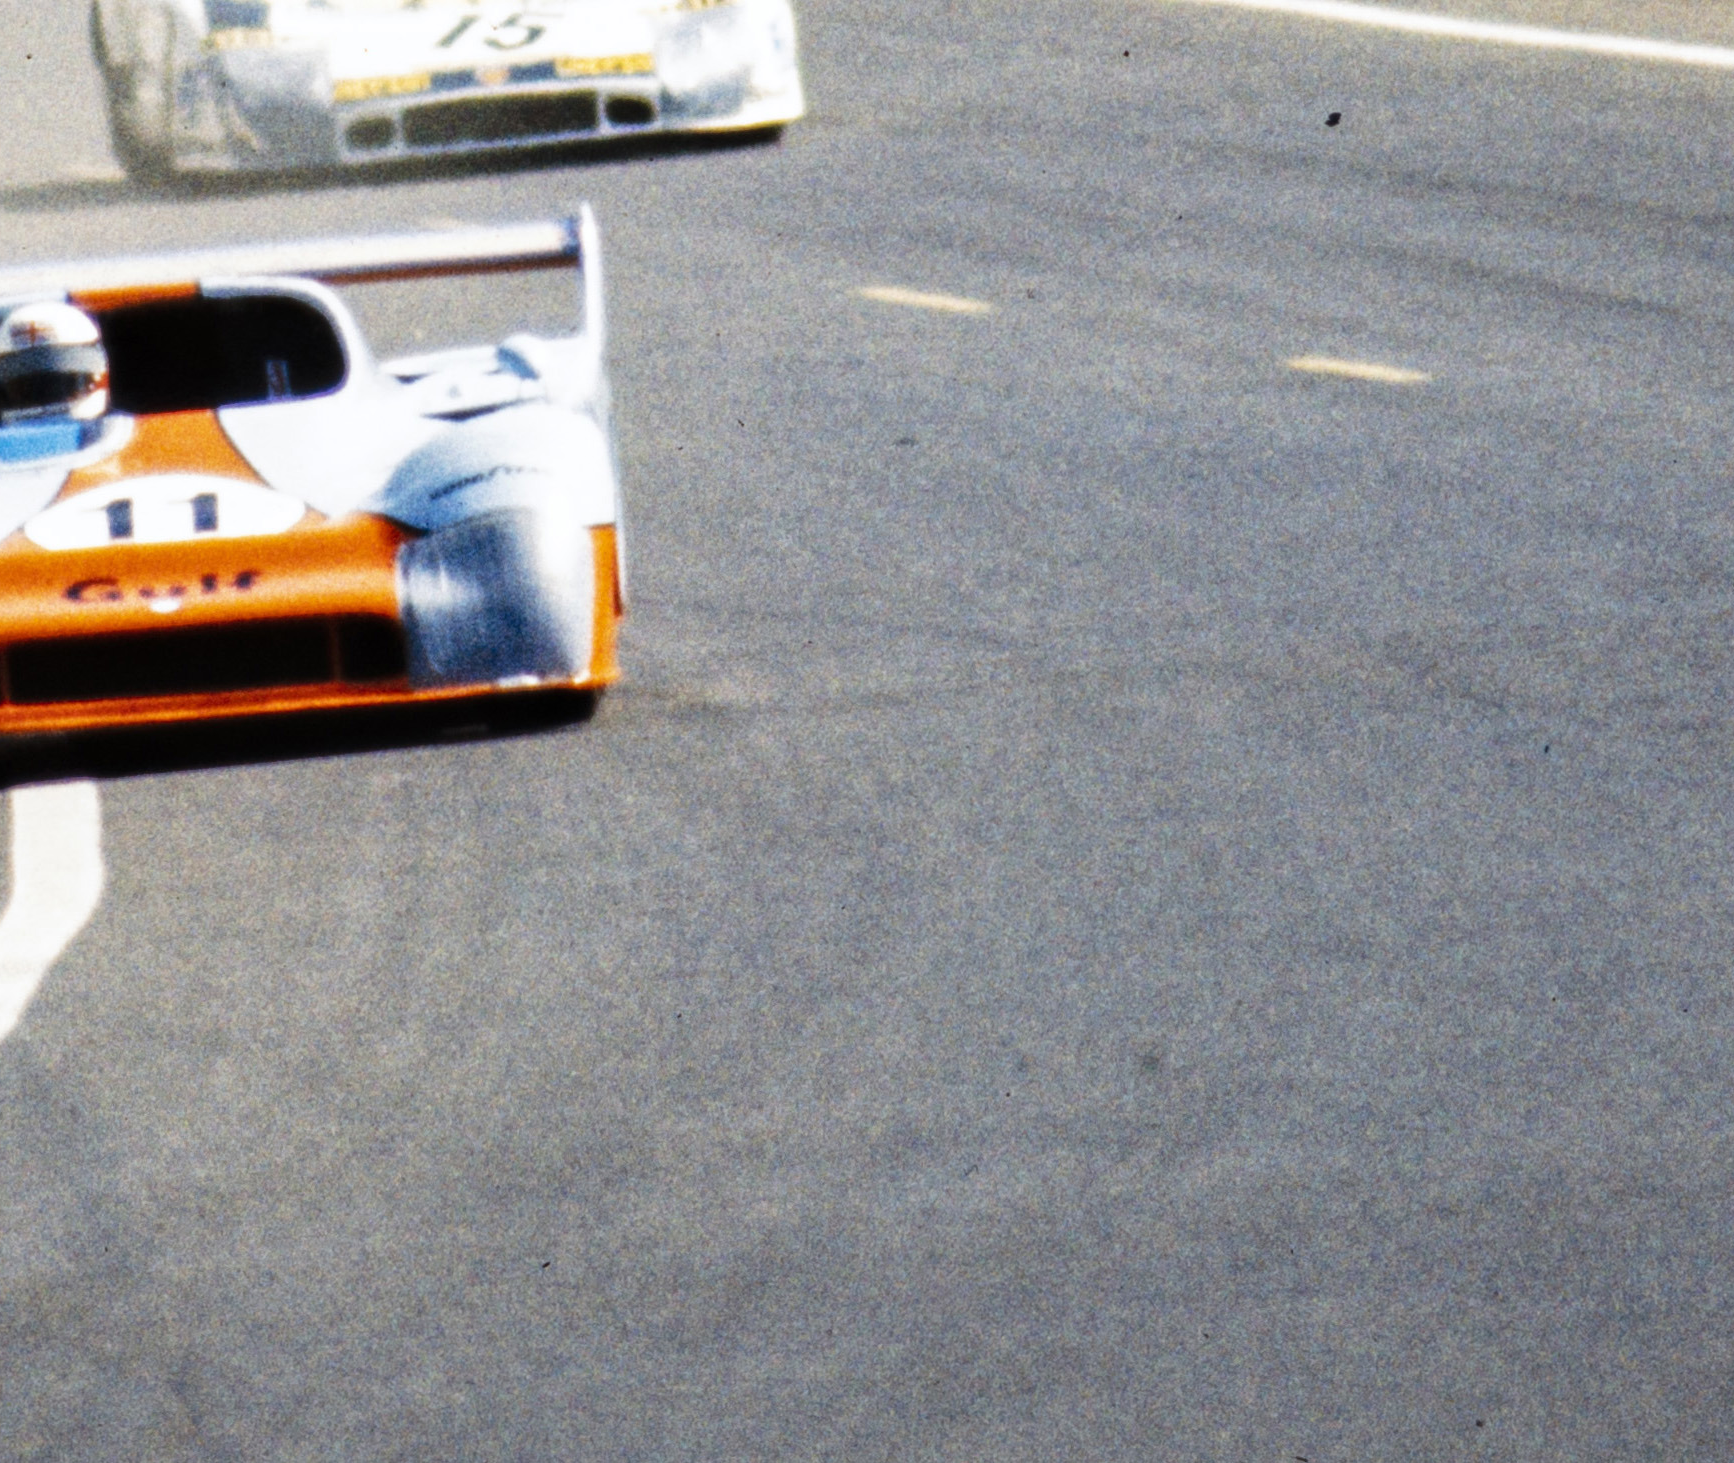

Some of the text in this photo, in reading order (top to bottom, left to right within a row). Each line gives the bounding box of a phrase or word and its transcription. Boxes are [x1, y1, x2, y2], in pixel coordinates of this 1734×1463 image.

[435, 13, 548, 51] 15
[93, 491, 220, 540] 11
[63, 568, 261, 603] Gulf
